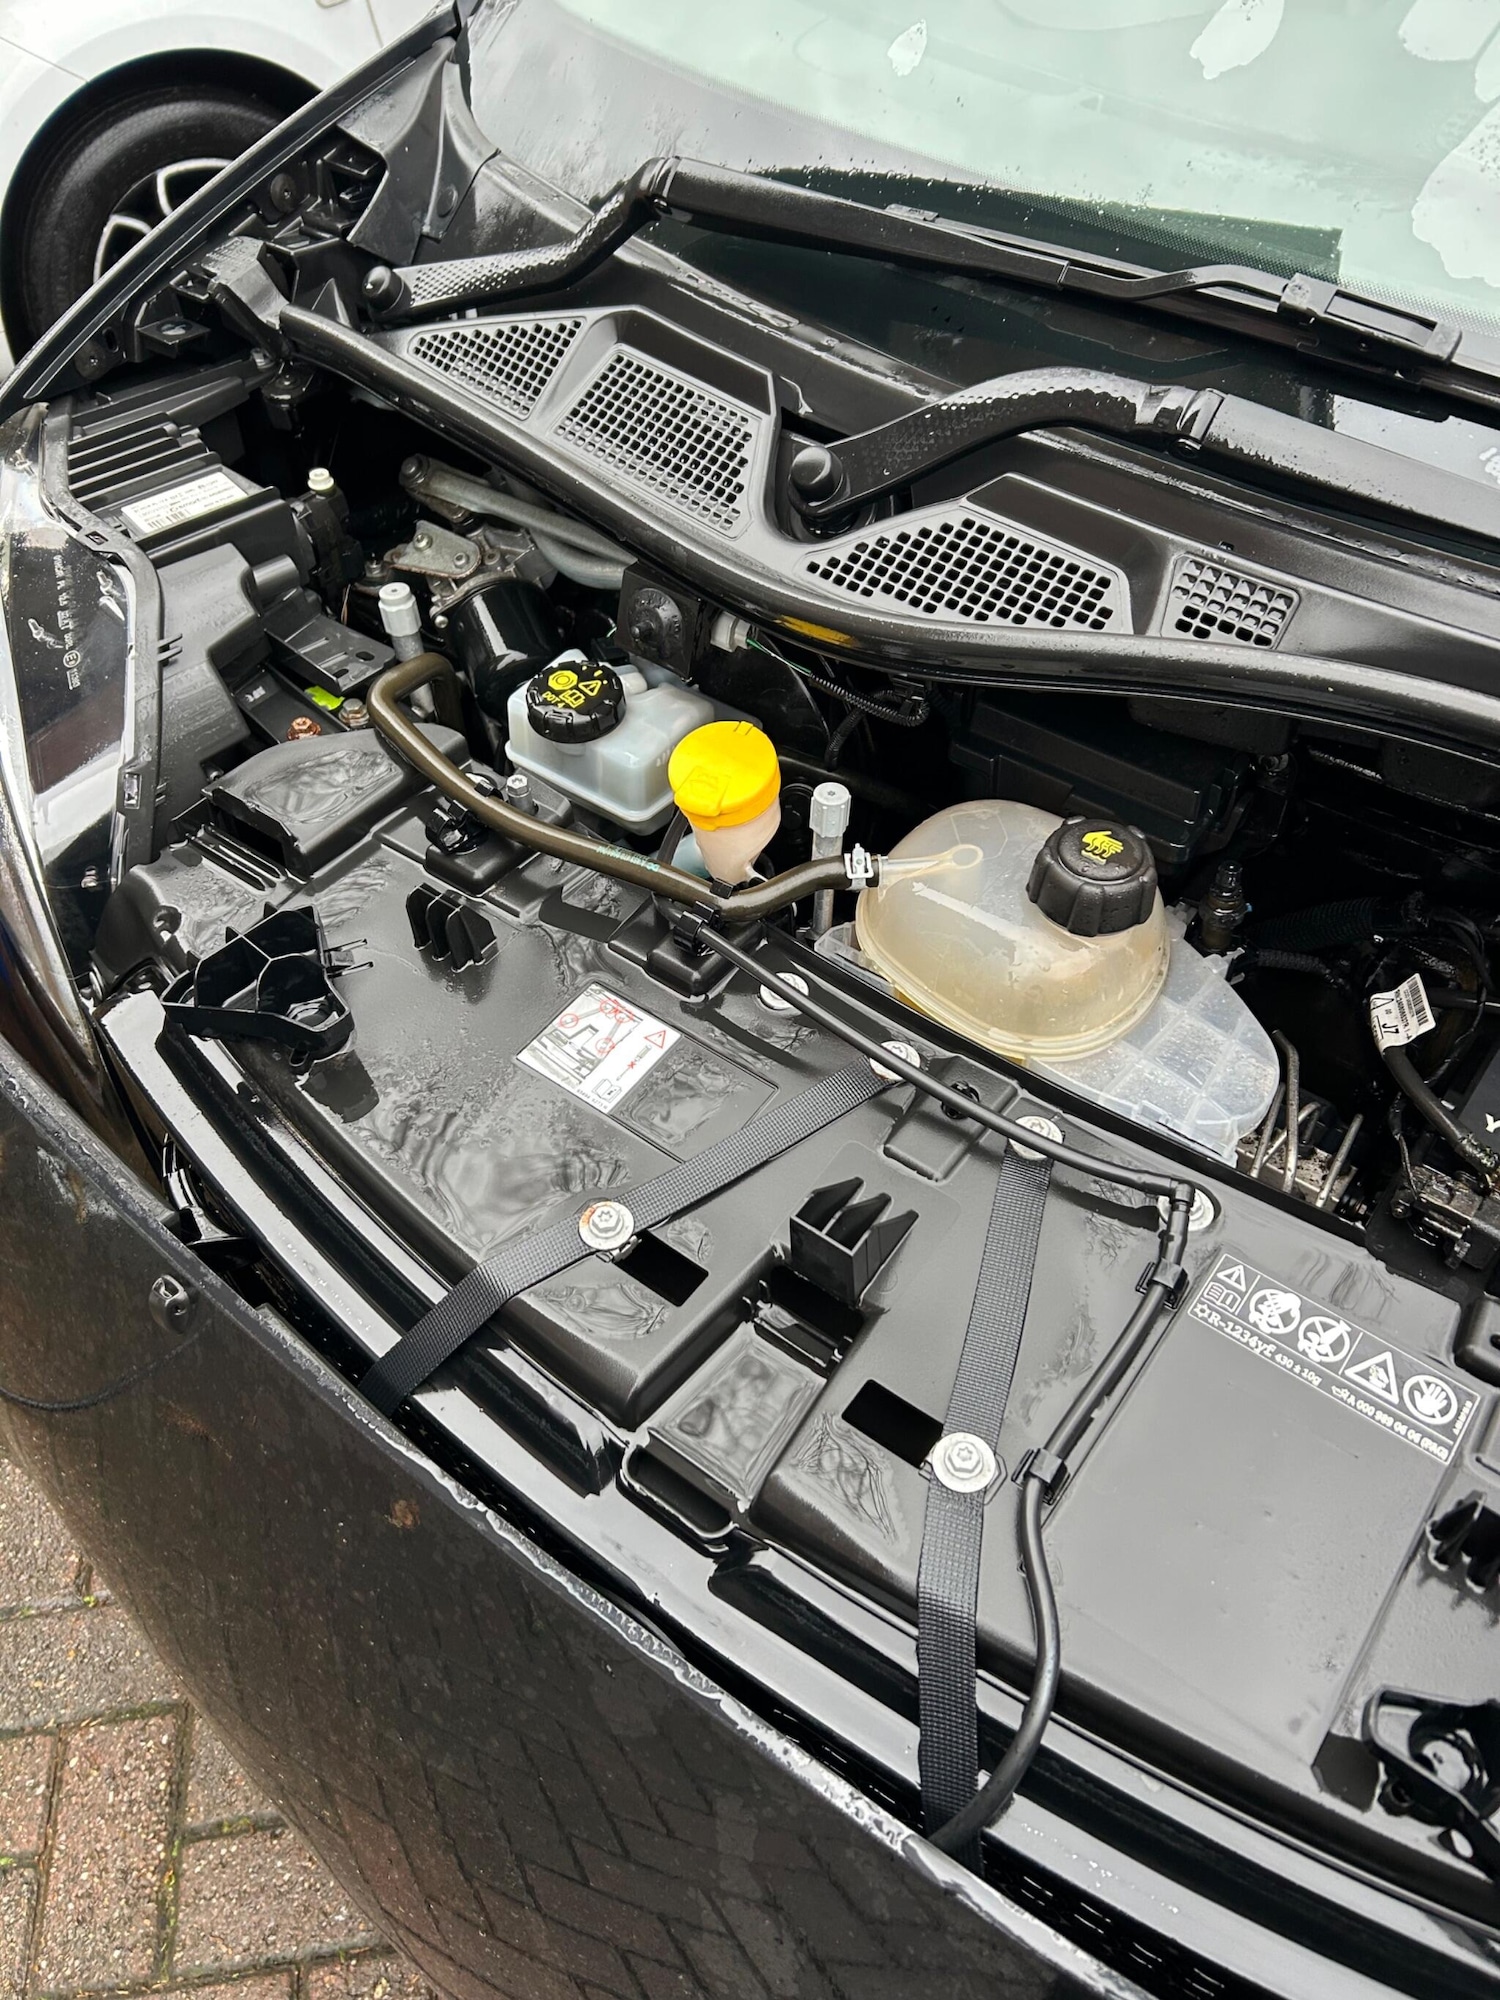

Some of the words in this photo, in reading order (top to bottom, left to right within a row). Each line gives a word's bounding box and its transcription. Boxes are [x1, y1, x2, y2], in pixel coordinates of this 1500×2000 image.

[542, 691, 560, 703] DOT
[1381, 1022, 1400, 1034] J7
[1209, 1311, 1277, 1357] R-1234yf
